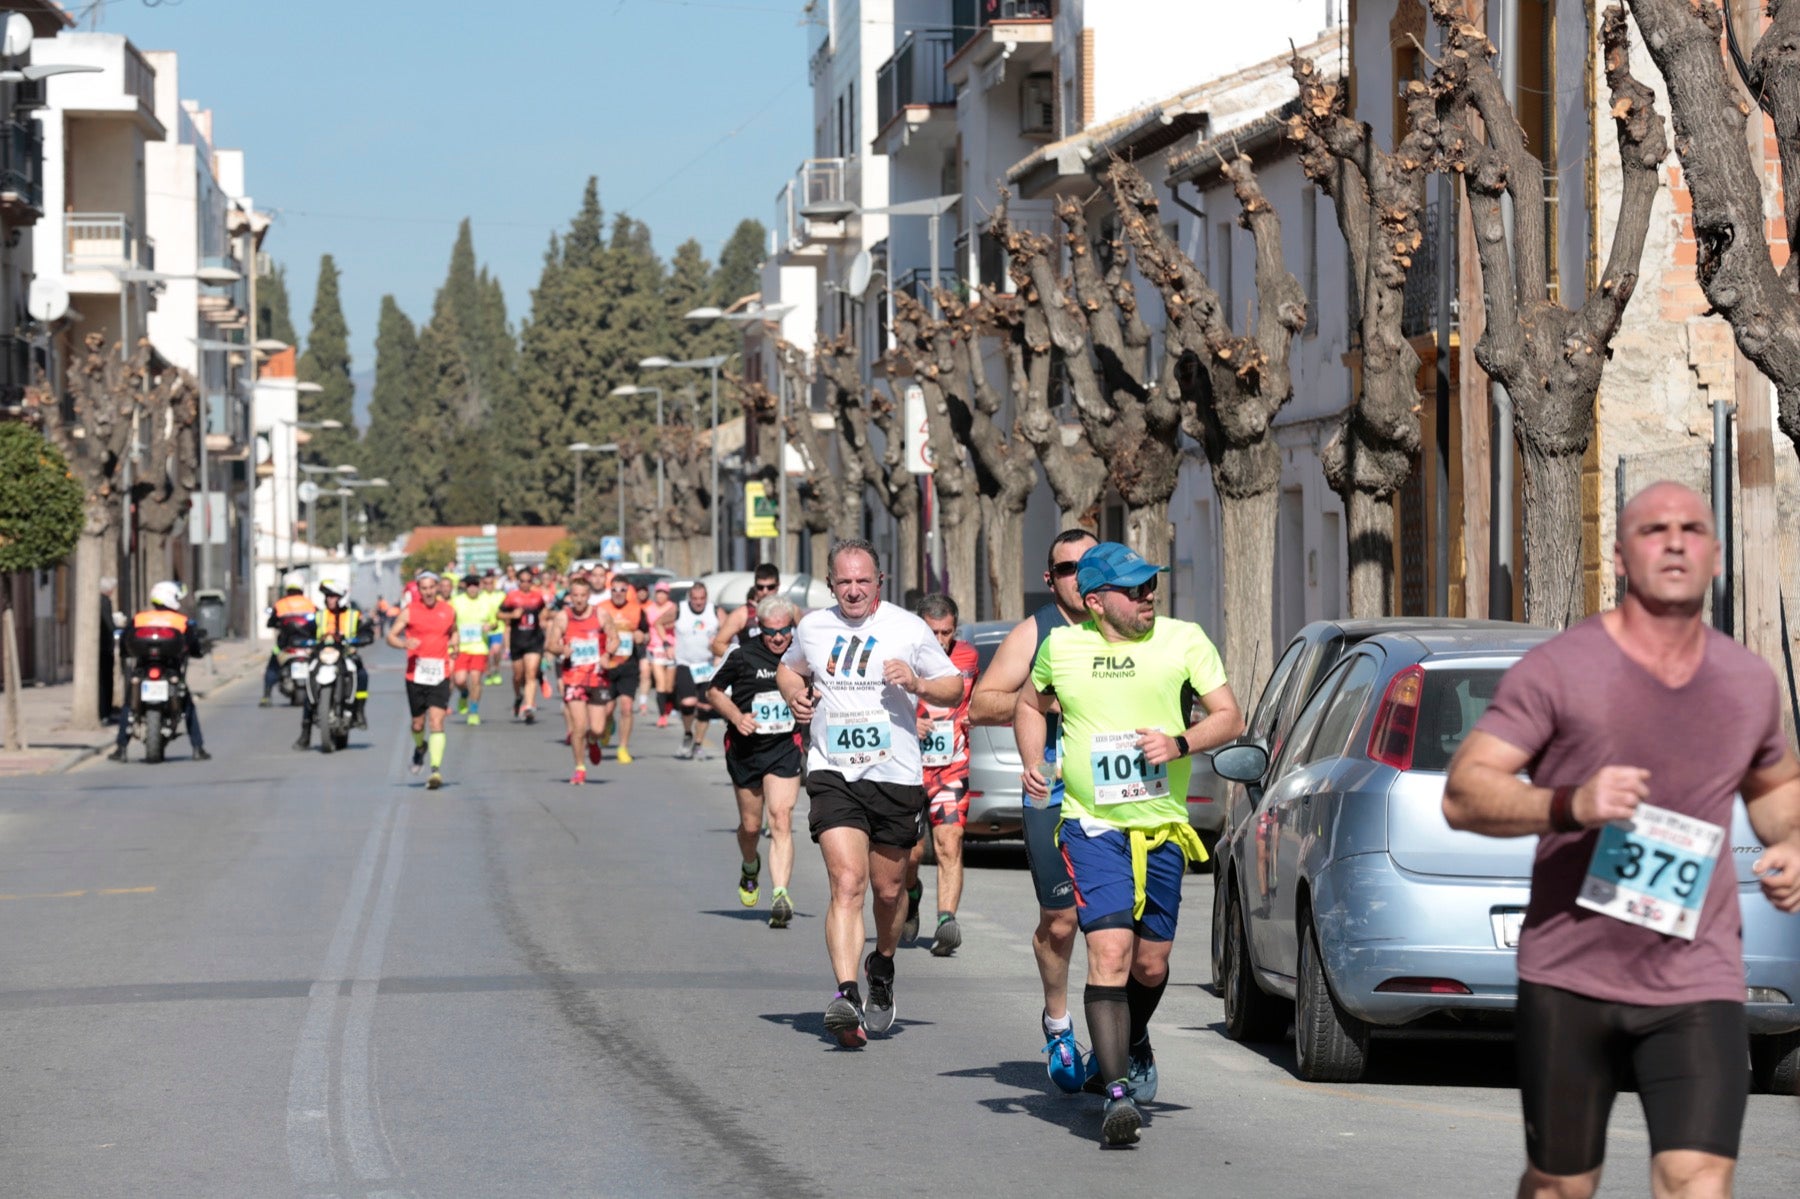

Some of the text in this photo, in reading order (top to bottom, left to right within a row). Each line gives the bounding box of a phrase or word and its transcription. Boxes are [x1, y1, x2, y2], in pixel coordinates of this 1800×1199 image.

[1093, 656, 1136, 670] FILA
[1092, 670, 1136, 679] RUNNING
[761, 704, 790, 720] 914
[837, 727, 881, 749] 463
[1615, 842, 1700, 898] 379
